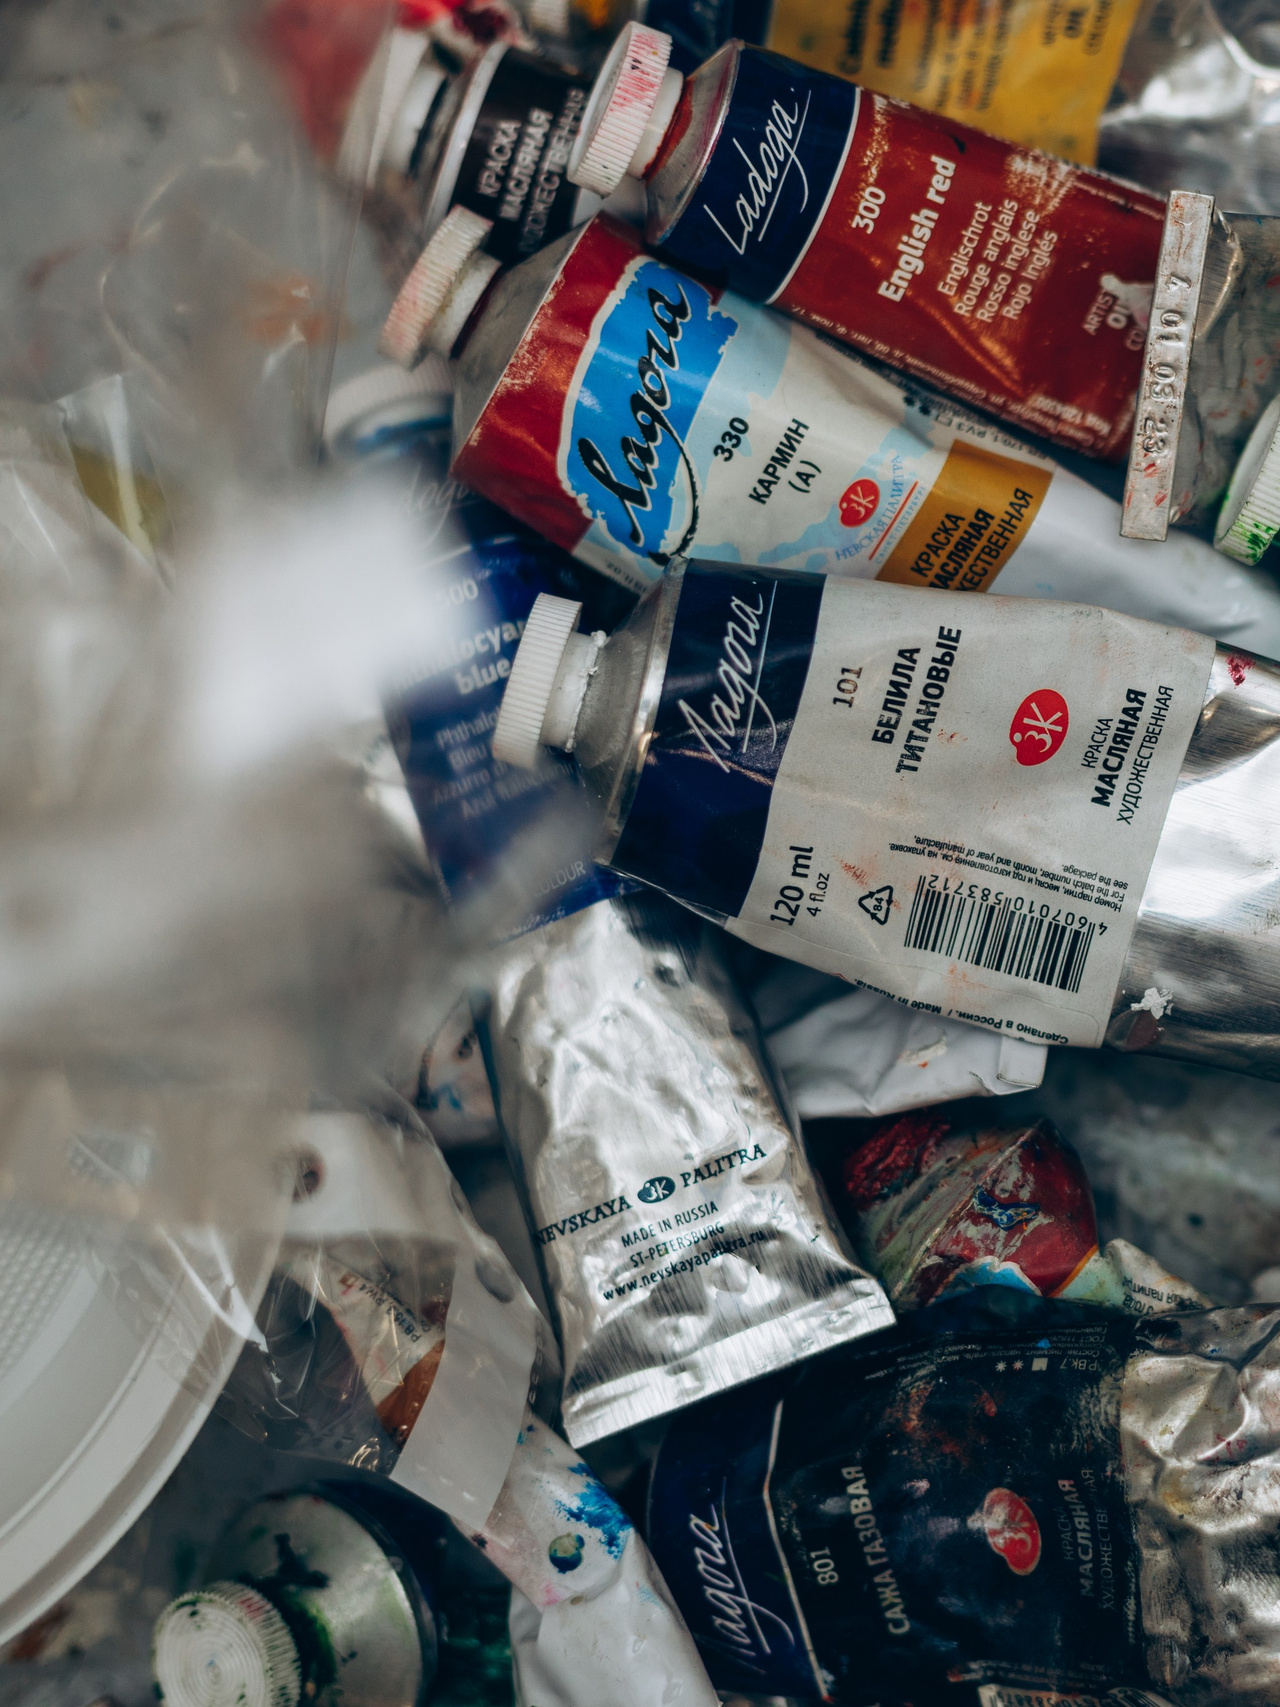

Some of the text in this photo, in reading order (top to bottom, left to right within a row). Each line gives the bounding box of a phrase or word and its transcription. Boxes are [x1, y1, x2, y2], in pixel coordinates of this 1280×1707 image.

[477, 121, 522, 197] КРАСКА
[703, 94, 811, 256] Ladoga
[850, 184, 888, 234] 300
[876, 203, 946, 306] English
[916, 153, 959, 204] red
[935, 199, 997, 299] Englischrot
[953, 197, 1024, 319] Rouge anglais
[976, 207, 1044, 324] Rosso inglese
[1002, 227, 1060, 323] Rojo Inglés
[710, 412, 753, 465] 330
[748, 416, 811, 507] КАРМИН
[909, 512, 965, 577] КРАСКА
[832, 662, 862, 708] 101
[871, 641, 921, 746] БЕЛИЛА
[895, 624, 962, 773] ТИТАНОВЫЕ
[1081, 717, 1113, 768] КРАСКА
[1090, 687, 1146, 806] МАСЛЯНАЯ
[1116, 685, 1173, 825] ХУДОЖЕСТВЕННАЯ
[926, 849, 938, 859] на
[954, 854, 1011, 879] изготовления
[964, 847, 975, 858] of
[976, 849, 995, 862] year
[995, 856, 1011, 868] and
[1011, 861, 1037, 876] month
[1011, 869, 1027, 882] год
[1037, 867, 1071, 886] number,
[1060, 862, 1128, 890] see the package.
[769, 841, 815, 925] 120 ml
[804, 869, 830, 918] 4 fl.oz
[926, 871, 1108, 936] 4 607010 583712
[1033, 876, 1060, 892] месяц
[1060, 885, 1093, 902] партии,
[1071, 879, 1095, 893] batch
[1093, 895, 1122, 912] Номер
[1095, 885, 1110, 897] the
[1110, 890, 1125, 902] For
[910, 998, 942, 1016] Made
[953, 1006, 1003, 1029] России.
[1004, 1019, 1013, 1028] в
[1015, 1021, 1069, 1045] Сделано
[533, 1143, 766, 1246] NEVSKAYA PALITRA
[620, 1200, 718, 1247] MADE IN RUSSIA
[629, 1220, 725, 1267] ST-PETERSBURG
[602, 1229, 766, 1301] www.nevskayapalitra.ru
[840, 1464, 911, 1635] САЖА ГАЗОВАЯ
[1057, 1477, 1094, 1598] МАСЛЯНАЯ
[809, 1545, 839, 1585] 801
